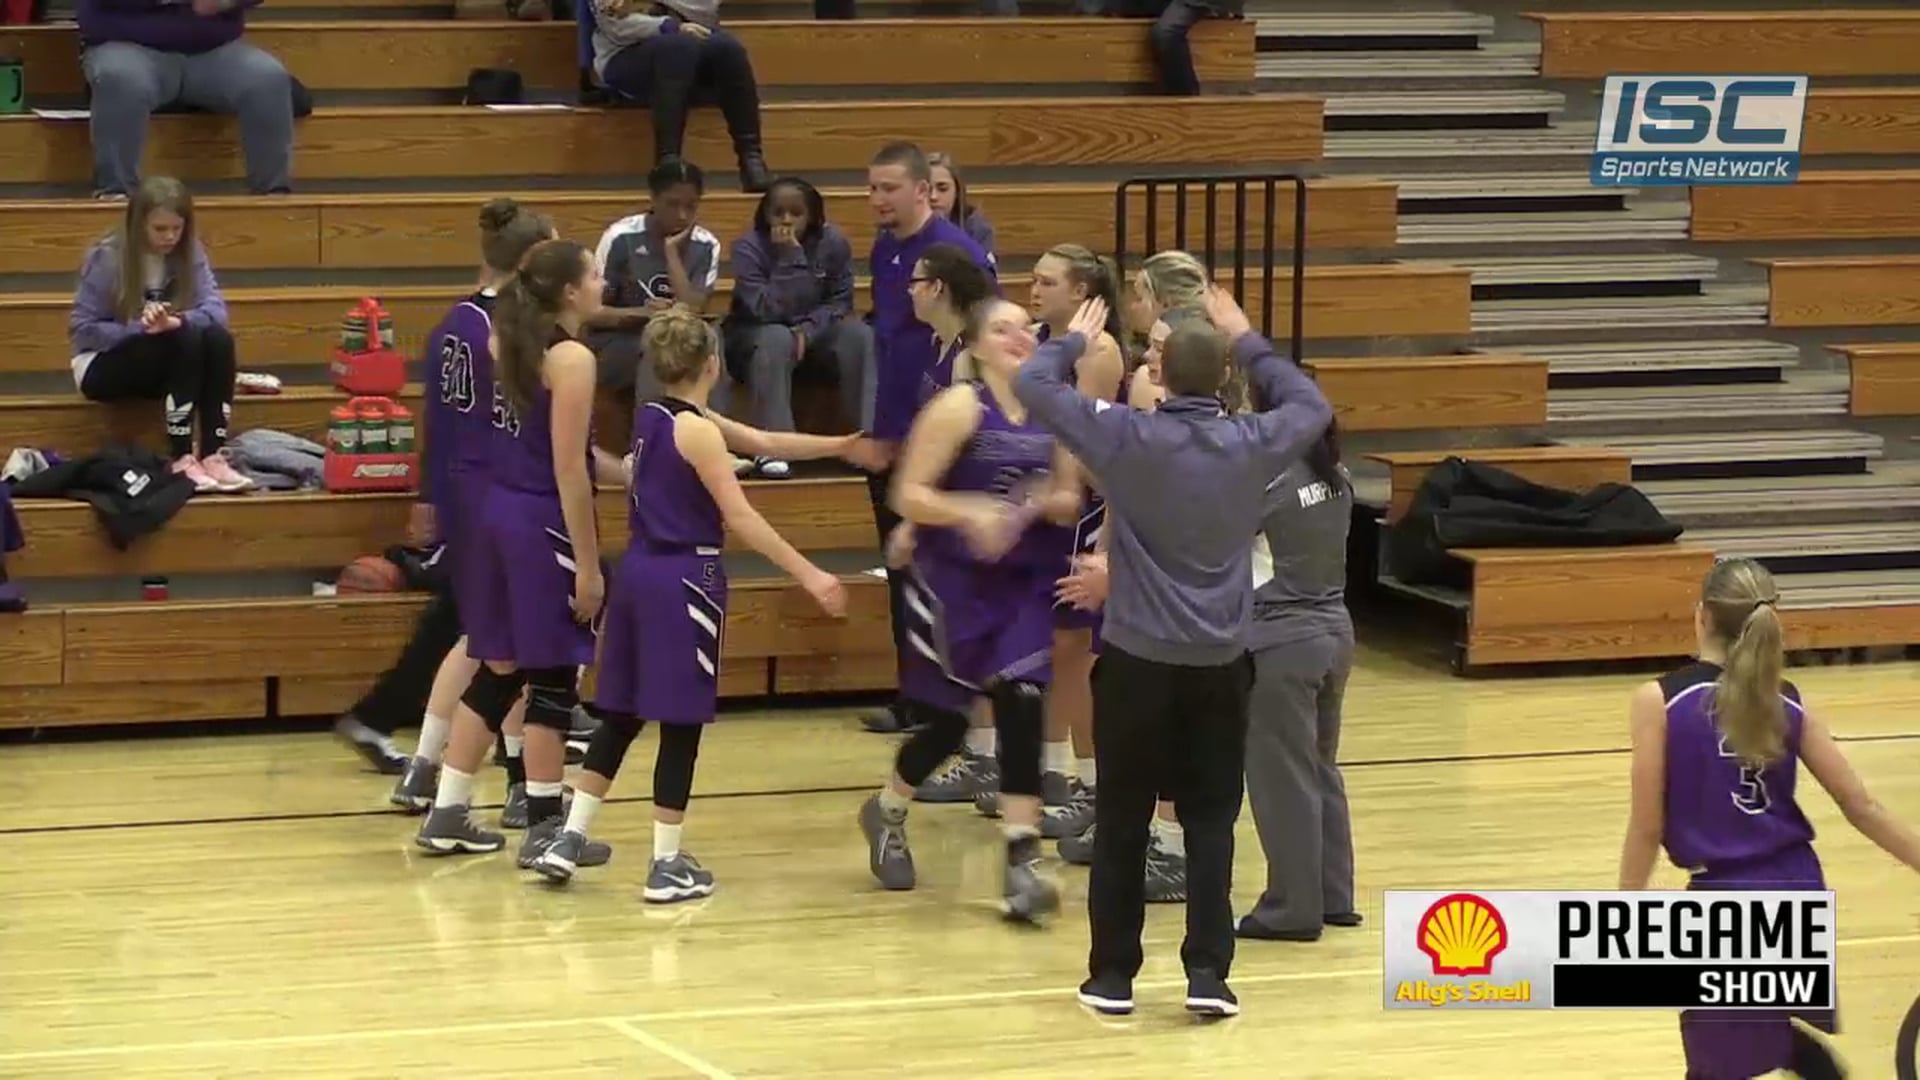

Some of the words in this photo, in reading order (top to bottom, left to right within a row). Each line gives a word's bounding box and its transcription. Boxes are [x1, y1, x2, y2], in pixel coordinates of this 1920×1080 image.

[440, 333, 475, 413] 30
[1297, 480, 1342, 508] MURP
[1718, 733, 1771, 815] 3
